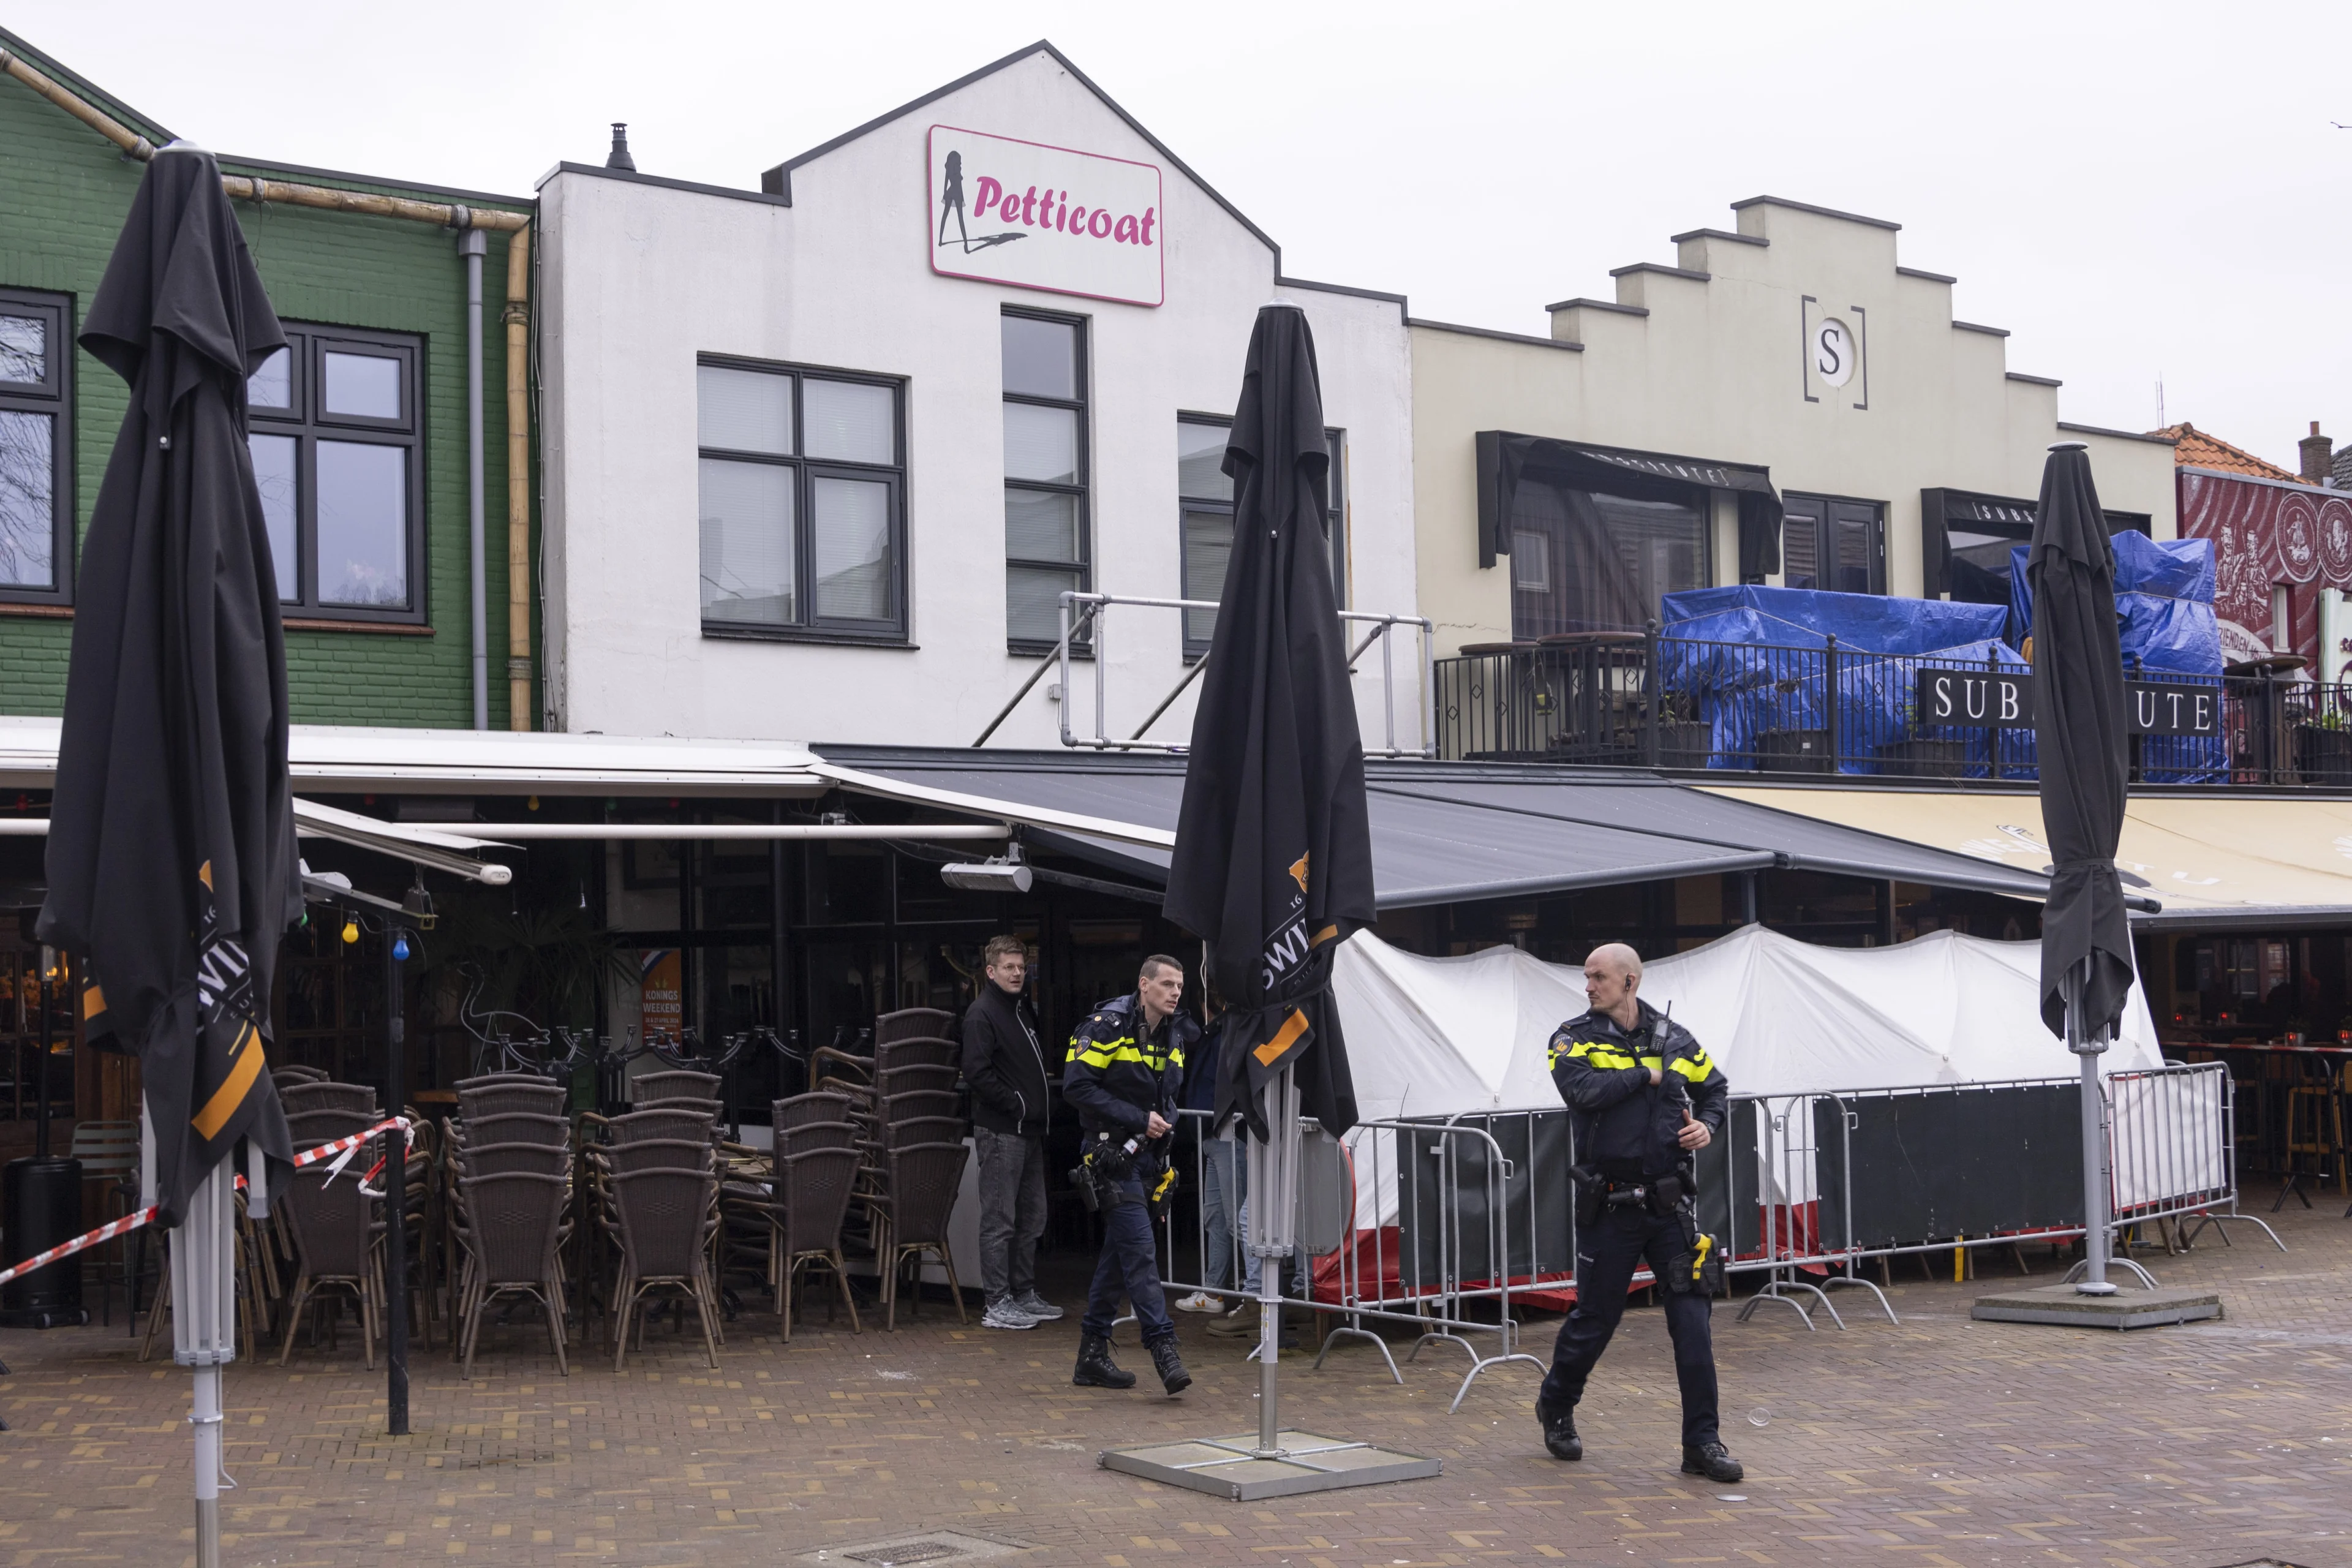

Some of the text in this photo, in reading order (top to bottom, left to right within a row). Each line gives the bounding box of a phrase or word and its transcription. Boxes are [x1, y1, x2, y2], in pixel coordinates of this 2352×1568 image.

[974, 176, 1155, 246] Petticoat
[1972, 501, 2037, 522] [SUBS
[2218, 627, 2250, 656] RIENDEN
[1936, 677, 2211, 730] SUBUTE
[1290, 894, 1302, 909] 16
[646, 990, 678, 1000] KONINGS
[643, 1003, 680, 1013] WEEKEND
